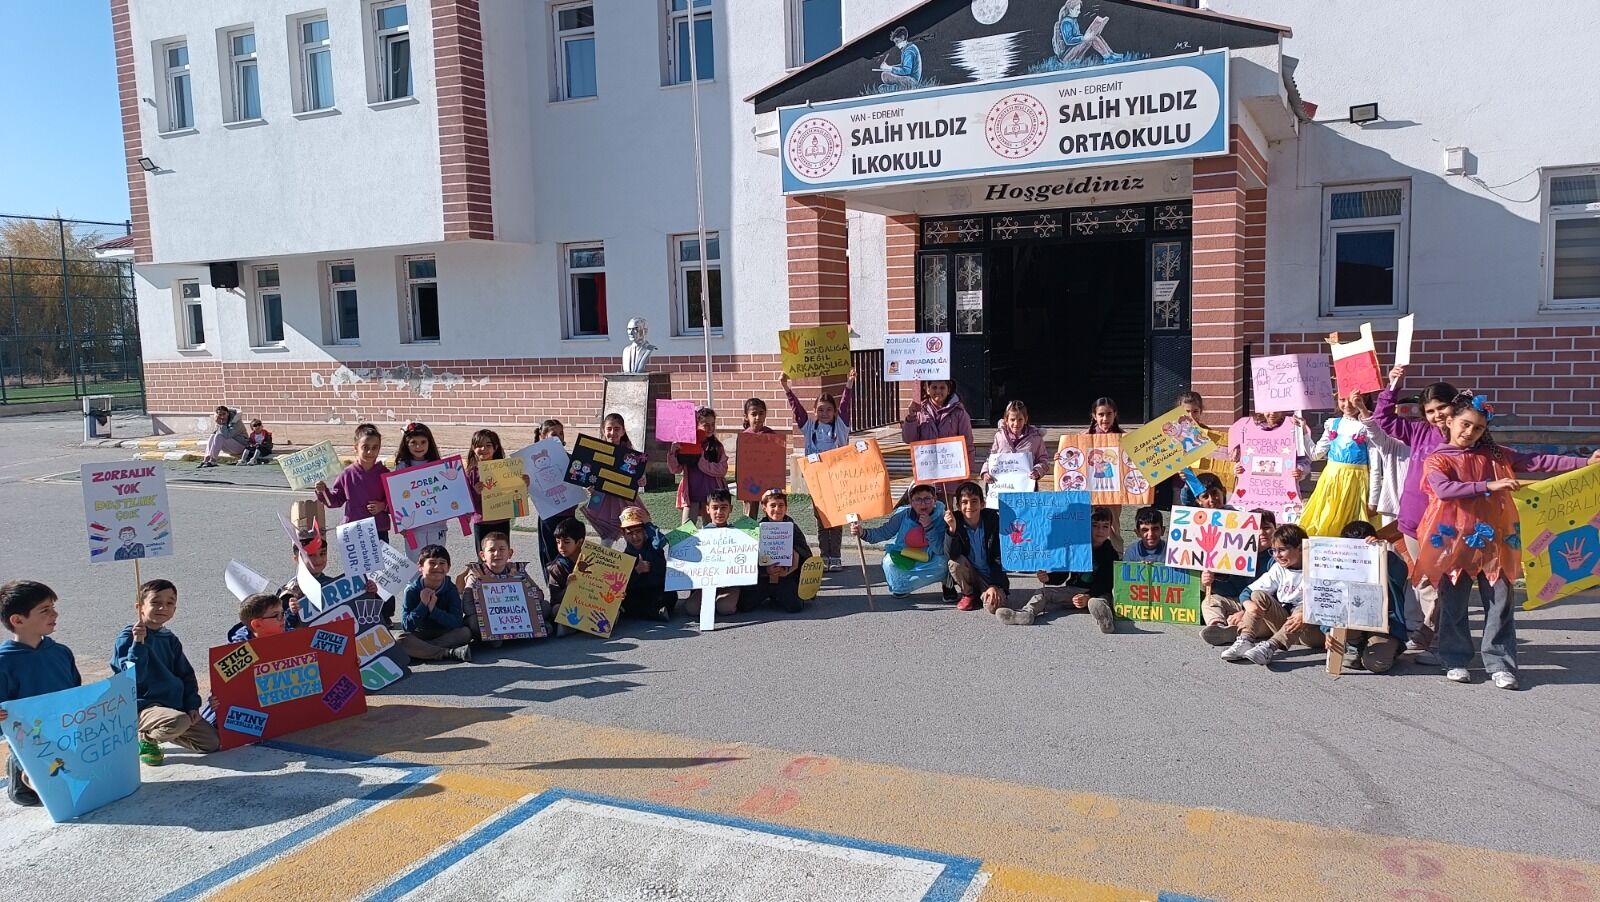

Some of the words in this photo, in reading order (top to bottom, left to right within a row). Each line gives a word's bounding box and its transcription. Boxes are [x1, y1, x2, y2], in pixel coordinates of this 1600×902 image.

[1059, 88, 1076, 98] VAN
[1084, 80, 1123, 94] EDREMİT
[850, 114, 866, 122] VAN
[872, 108, 904, 120] EDREMİT
[1059, 96, 1120, 124] SALİH
[1124, 90, 1197, 116] YILDIZ
[851, 121, 903, 146] SALİH
[907, 116, 967, 140] YILDIZ
[1059, 123, 1190, 155] ORTAOKULU
[852, 150, 942, 175] İLKOKULU
[984, 176, 1144, 202] Hoşgeldiniz
[92, 466, 156, 482] ZORBALIK
[410, 476, 439, 489] ZORBA
[112, 482, 140, 495] YOK
[421, 484, 448, 496] OLMA
[1173, 510, 1259, 530] ZORBA
[369, 571, 391, 587] EVET
[300, 575, 366, 619] ZRBA
[1130, 585, 1160, 602] SEN
[1165, 588, 1184, 604] AT
[1114, 602, 1163, 621] ÖFKENİ
[1171, 608, 1196, 622] YEN
[313, 640, 343, 653] ALAY
[274, 652, 317, 670] KANKA
[256, 664, 318, 692] OLMA
[228, 710, 266, 725] ANLAT
[37, 716, 122, 758] ZORBAYI
